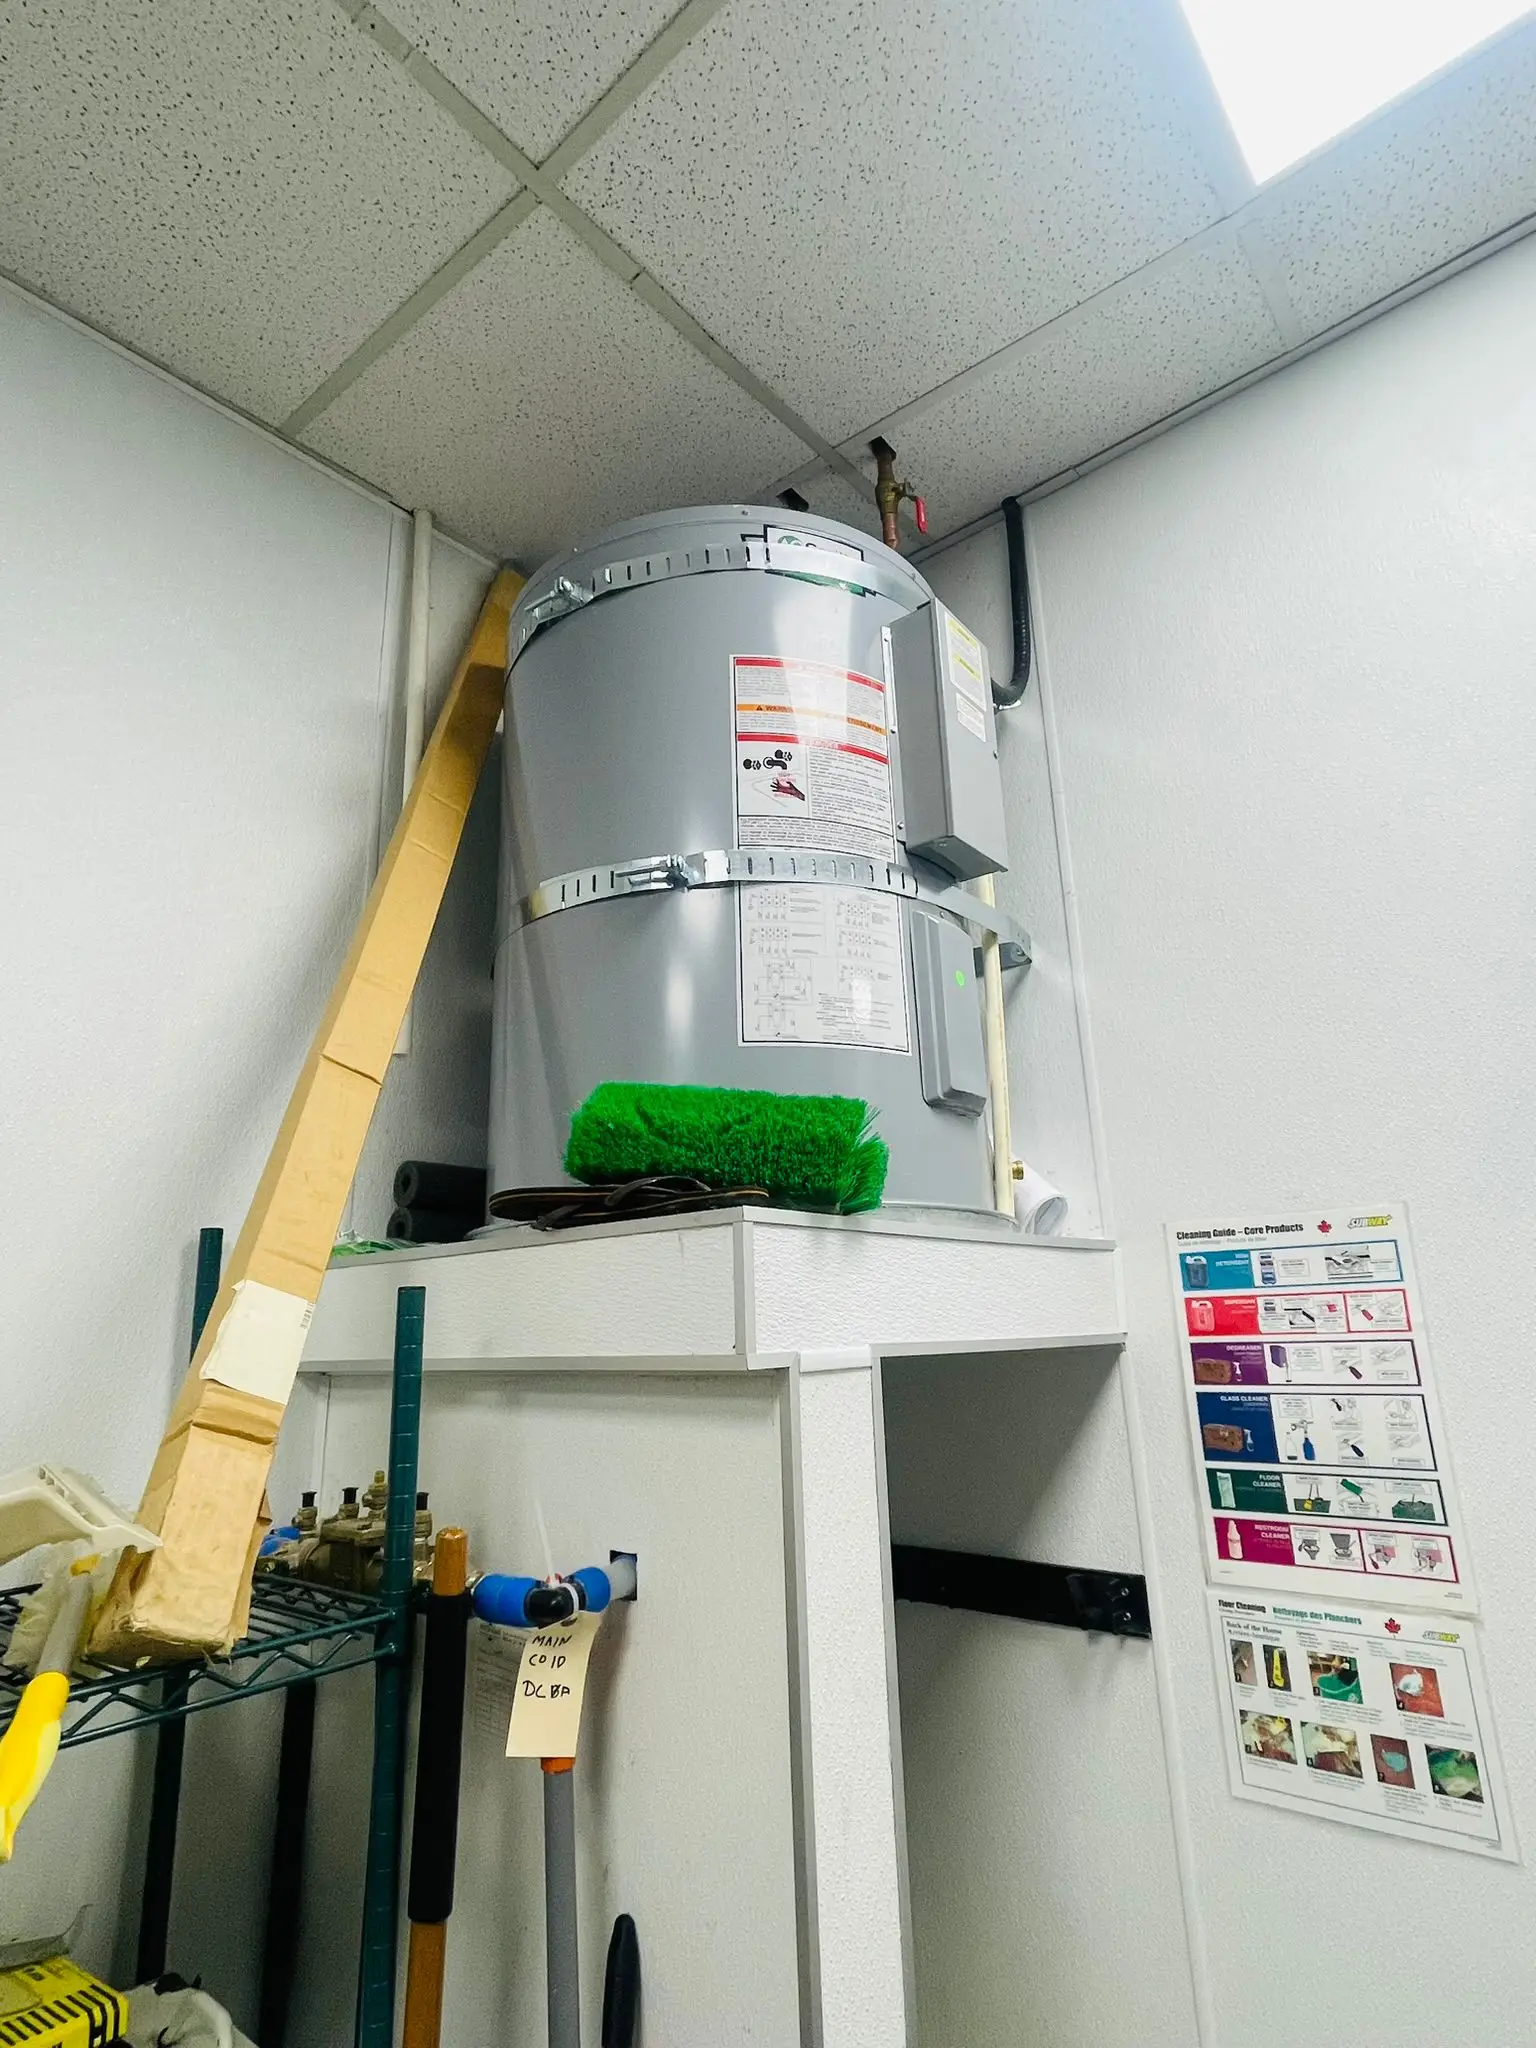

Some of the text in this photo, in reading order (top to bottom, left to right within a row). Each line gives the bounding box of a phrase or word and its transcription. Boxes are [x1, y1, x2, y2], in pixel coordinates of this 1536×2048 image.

[1176, 1230, 1212, 1240] Cleaning
[1212, 1228, 1236, 1238] Guide
[1244, 1226, 1264, 1235] Core
[1265, 1223, 1304, 1234] Products
[1252, 1480, 1282, 1488] CLEANER
[1236, 1601, 1267, 1614] Cleaning
[531, 1634, 573, 1648] MAIN
